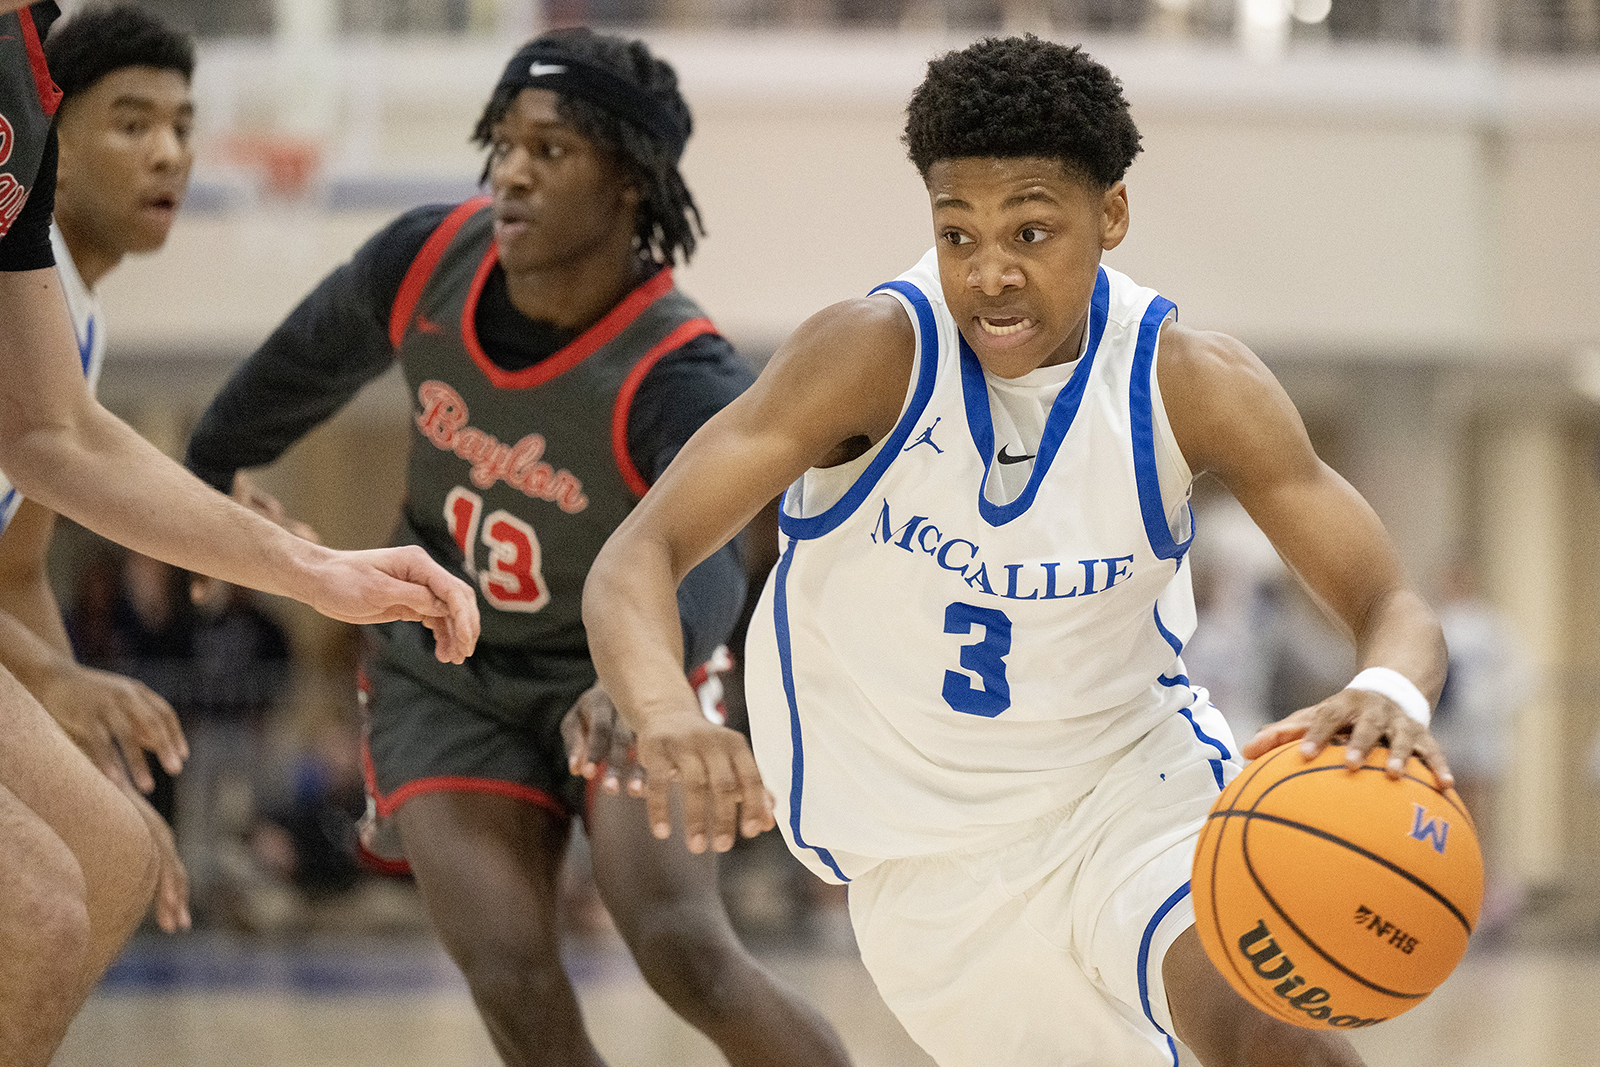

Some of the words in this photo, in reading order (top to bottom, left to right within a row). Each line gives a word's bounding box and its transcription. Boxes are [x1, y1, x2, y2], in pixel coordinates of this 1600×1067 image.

[415, 380, 588, 514] Baylor
[443, 486, 550, 613] 13
[941, 601, 1013, 718] 3
[1367, 914, 1420, 955] NFHS
